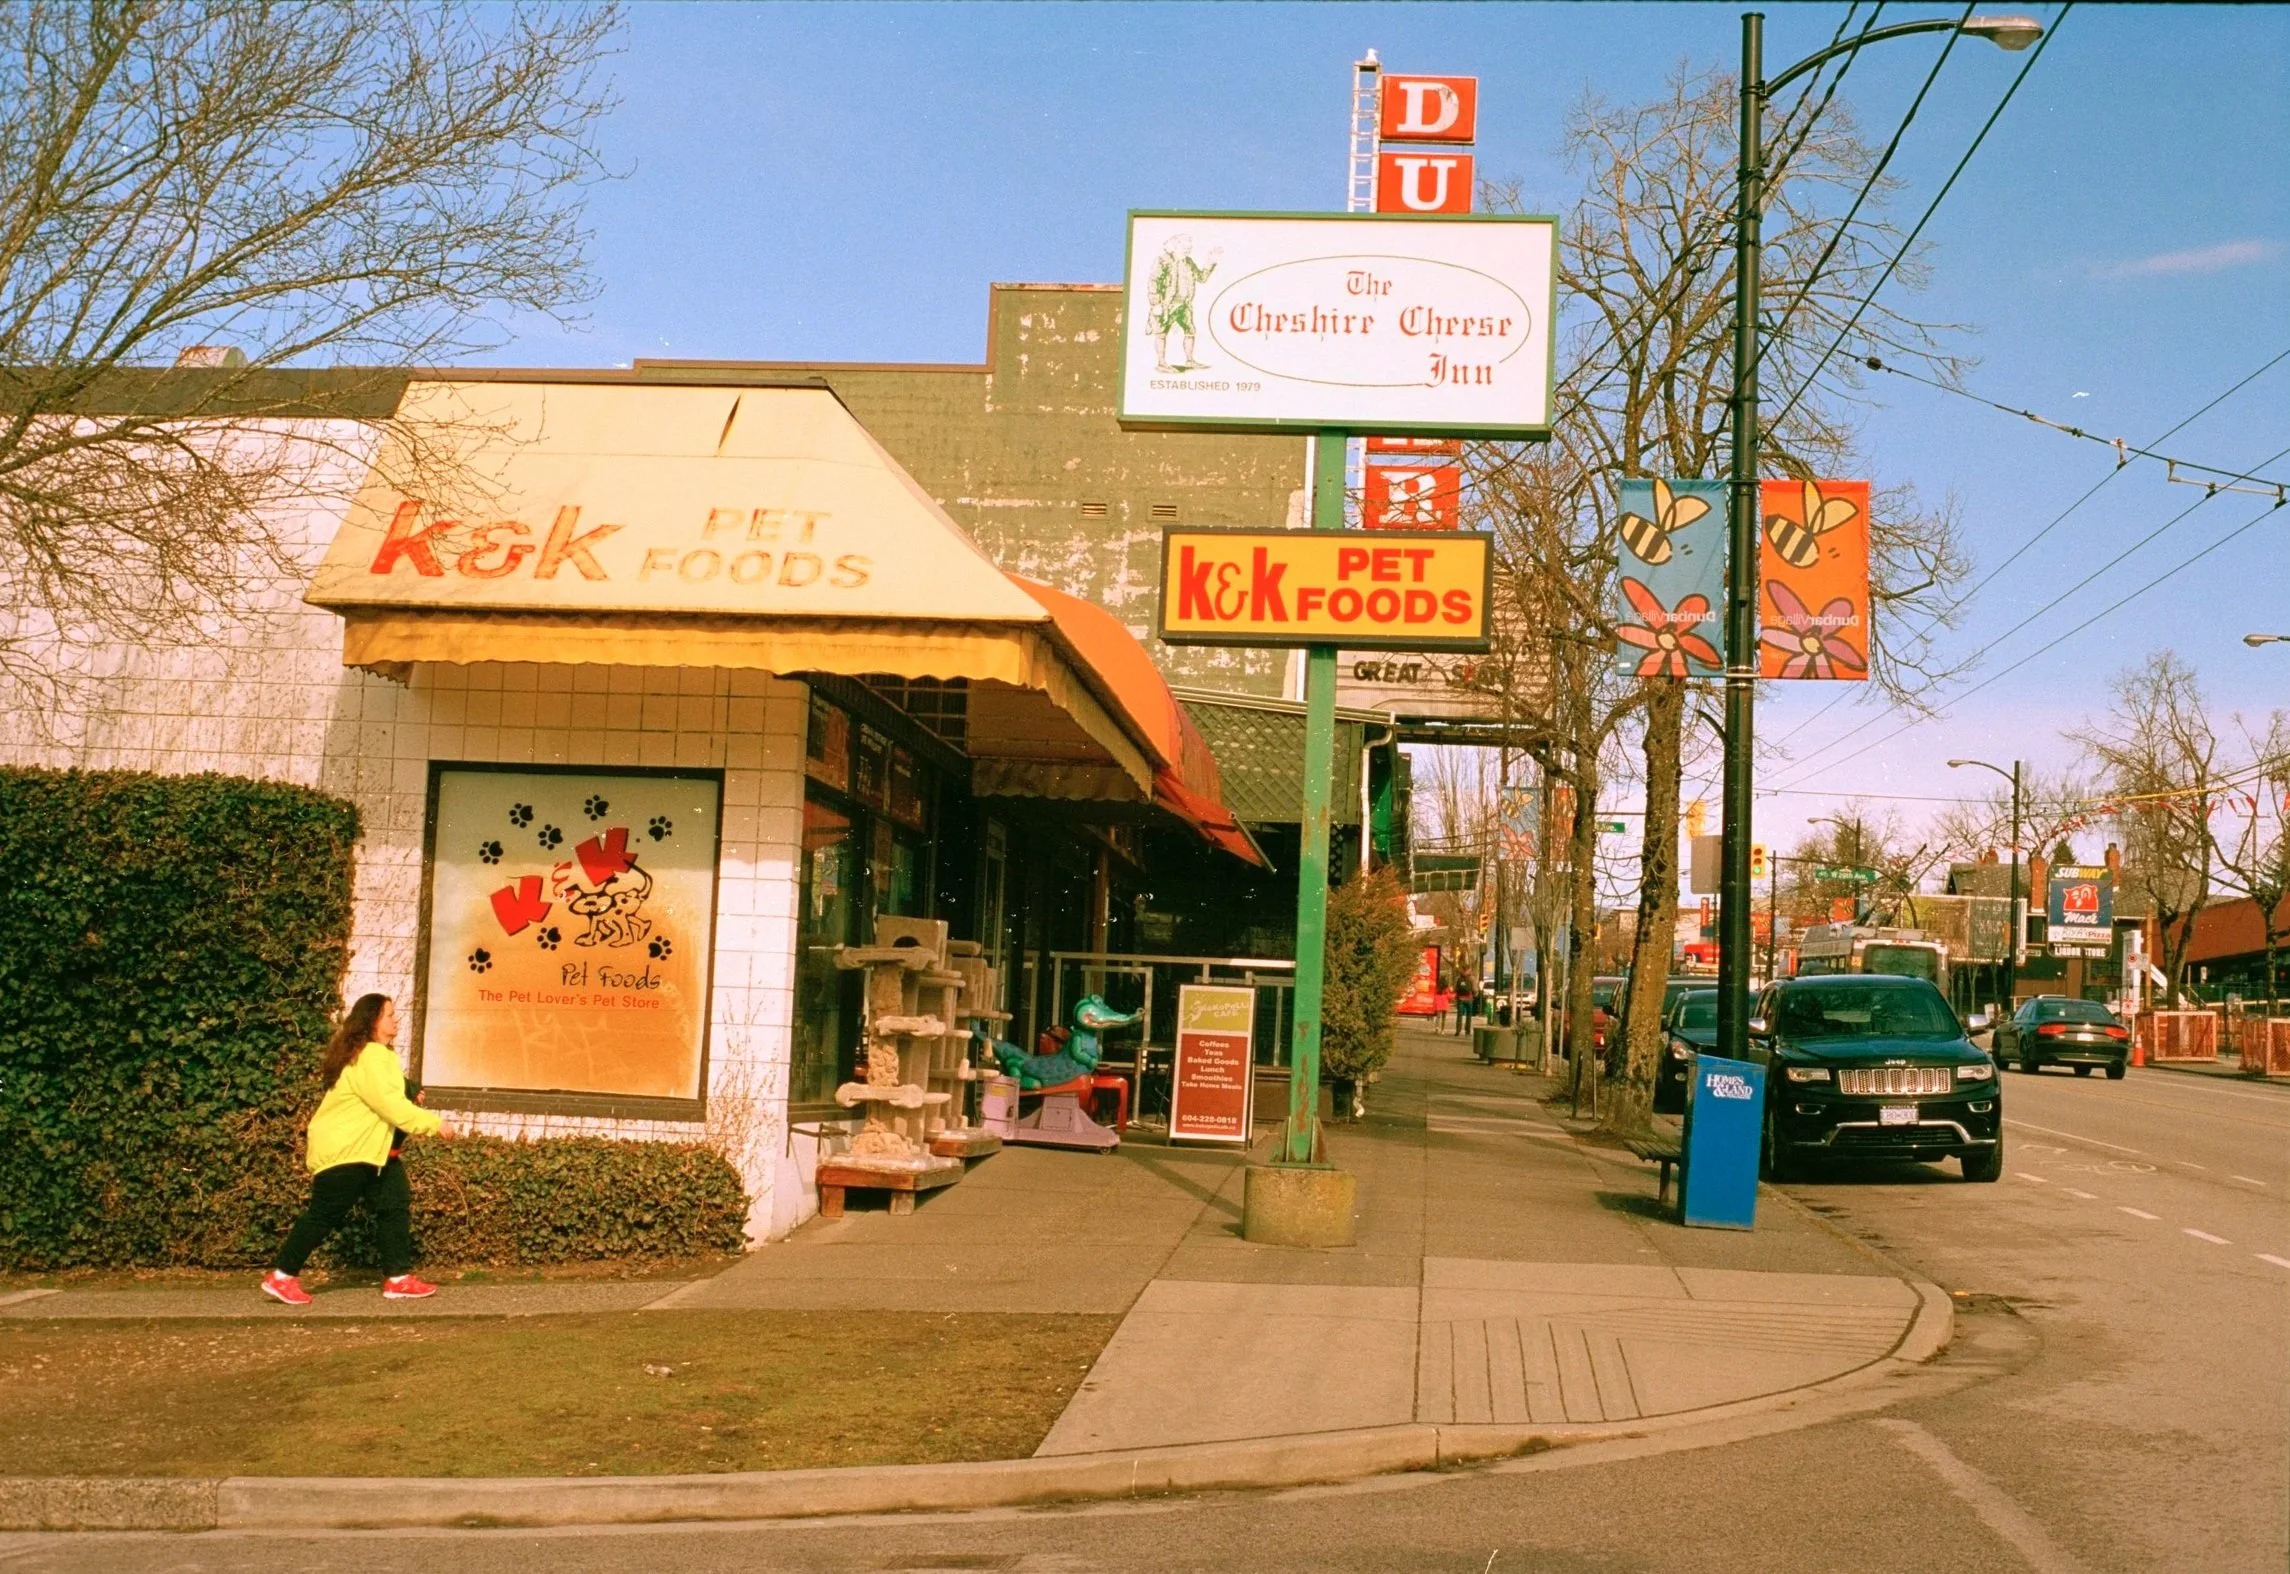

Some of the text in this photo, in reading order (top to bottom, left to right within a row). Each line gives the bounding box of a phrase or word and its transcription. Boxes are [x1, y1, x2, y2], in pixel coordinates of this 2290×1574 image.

[1346, 270, 1393, 301] The
[1229, 302, 1513, 344] Cheshire Cheese
[1424, 352, 1493, 389] Inn
[1149, 379, 1262, 393] ESTABLISHED 1979
[700, 506, 833, 544] PET
[635, 547, 877, 589] FOODS
[1337, 547, 1435, 582] PET
[1296, 587, 1474, 625] FOODS
[1353, 661, 1423, 683] GREAT
[2055, 867, 2108, 879] SUBWAY
[561, 961, 661, 989] Pet Foods
[478, 989, 660, 1010] The Pet Lover's Pet Store
[1199, 1039, 1230, 1049] Coffees
[1204, 1048, 1224, 1057] Teas
[1187, 1057, 1240, 1066] Baked Goods
[1200, 1065, 1225, 1074] Lunch
[1884, 1058, 1906, 1067] Jeep
[1191, 1073, 1233, 1083] Smoothies
[1706, 1073, 1745, 1087] HOMES
[1724, 1084, 1753, 1097] LAND
